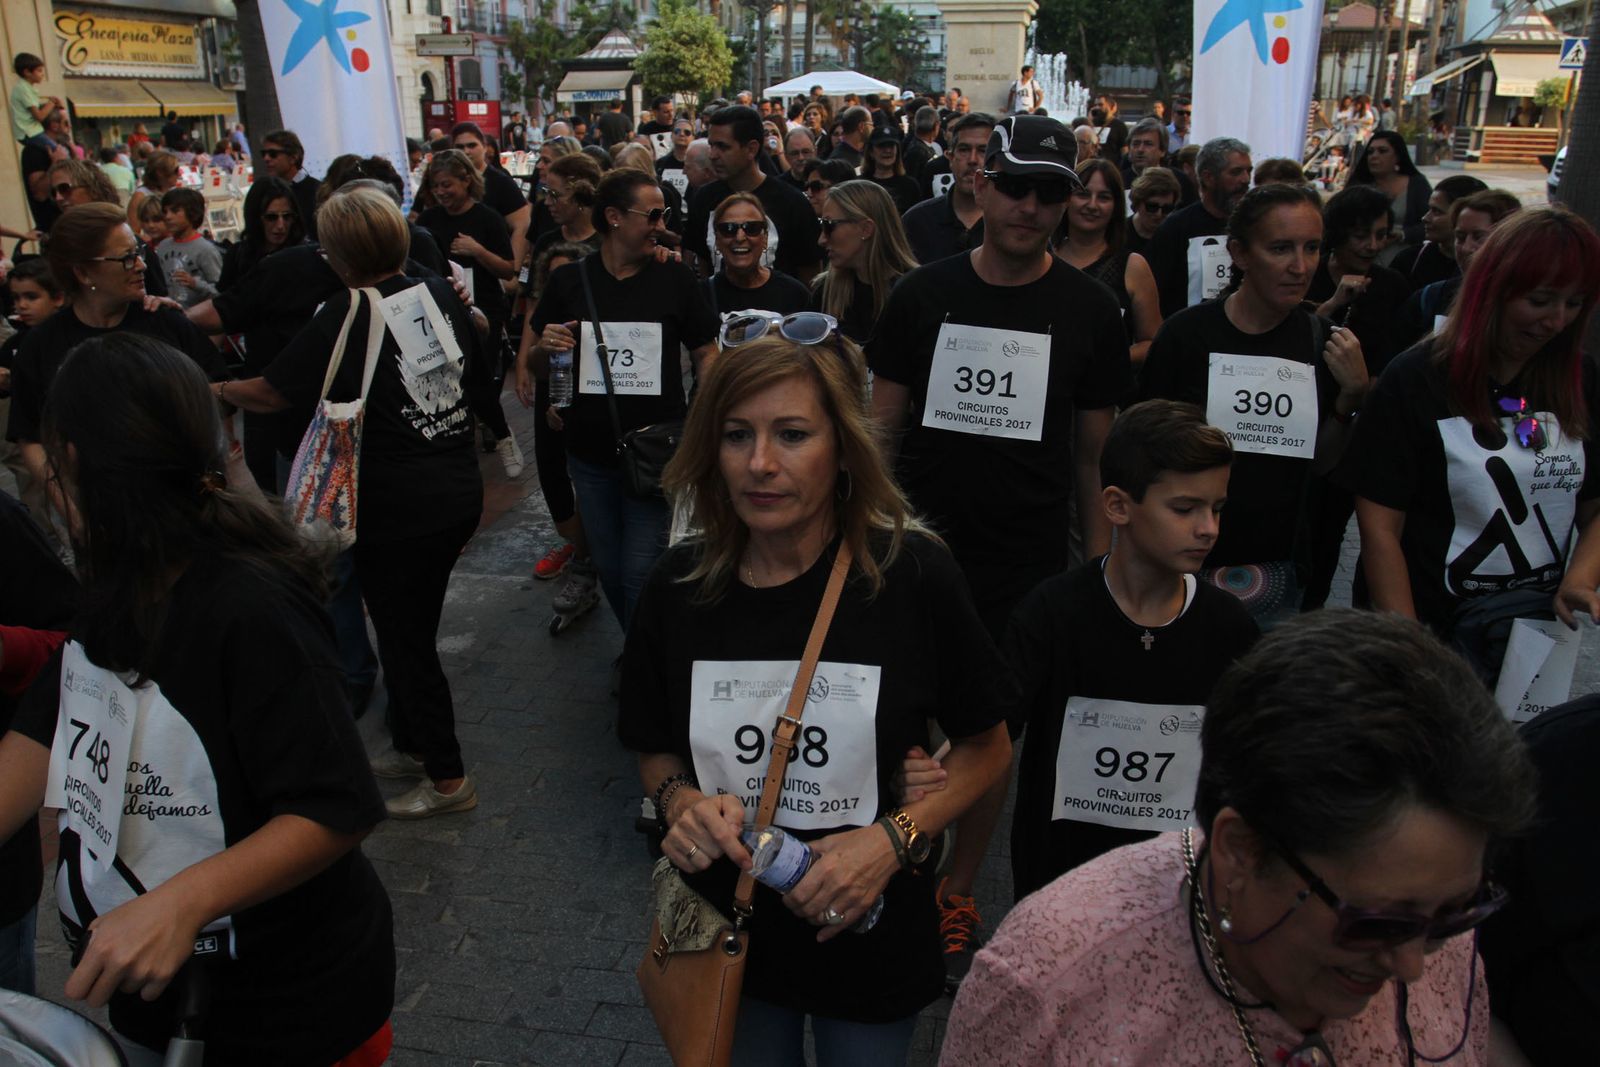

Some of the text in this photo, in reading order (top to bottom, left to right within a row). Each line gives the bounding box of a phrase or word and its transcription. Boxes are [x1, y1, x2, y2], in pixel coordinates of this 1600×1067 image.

[151, 25, 194, 46] Plaza
[586, 380, 634, 388] PROVCIALES
[610, 372, 638, 380] RCUITOS
[953, 366, 1017, 399] 391
[957, 401, 1009, 416] CIRCUITOS
[1233, 389, 1293, 418] 390
[934, 409, 1032, 430] PROVINCIALES 2017
[1236, 421, 1285, 434] CIRCUITOS
[1226, 432, 1306, 448] OVINCIALES 2017
[1535, 451, 1573, 465] Somos
[1533, 461, 1582, 478] la huella
[1530, 482, 1551, 495] que
[68, 718, 110, 785] 748
[1094, 746, 1176, 783] 987
[124, 776, 173, 797] uella
[1096, 787, 1162, 803] CIRCUITOS
[123, 795, 212, 821] dejamos
[819, 797, 860, 813] 2017
[1063, 796, 1191, 821] PROVINCIALES 2017
[67, 795, 113, 847] NCIALES 2017
